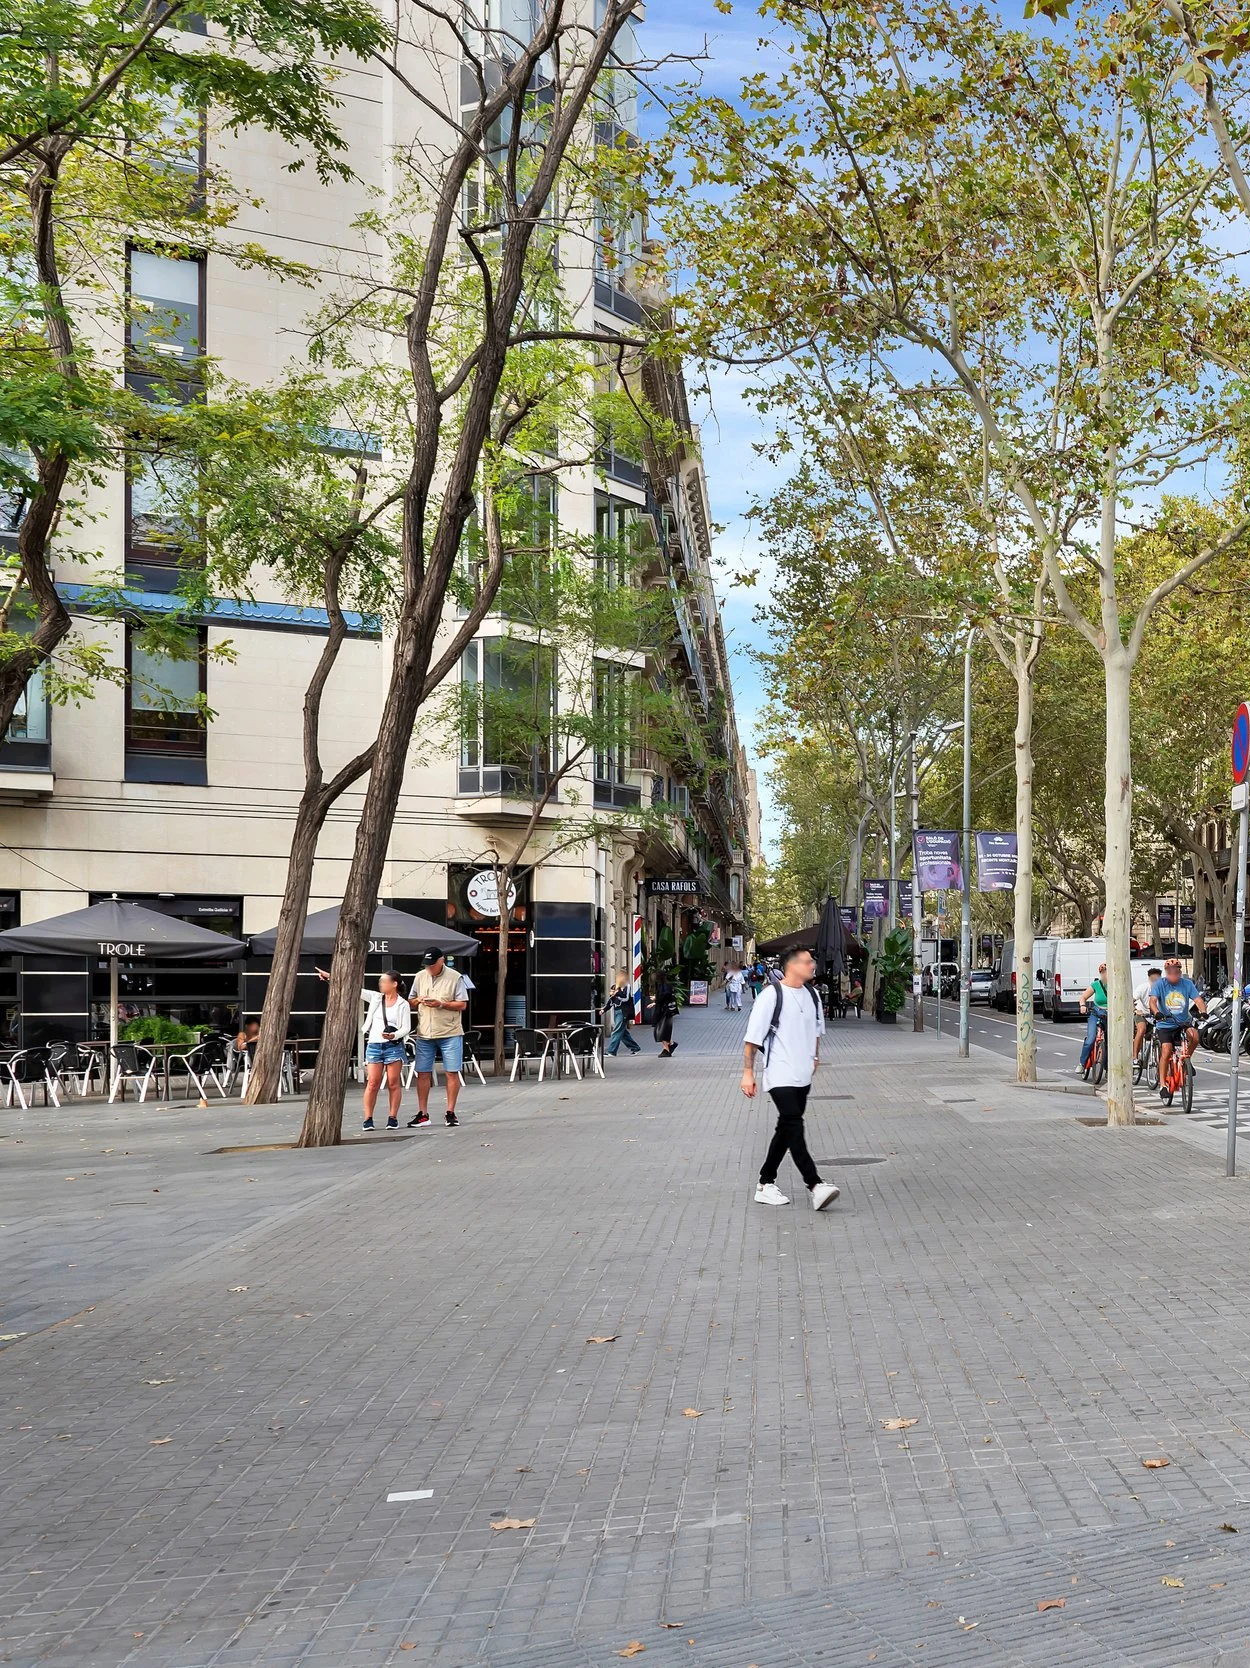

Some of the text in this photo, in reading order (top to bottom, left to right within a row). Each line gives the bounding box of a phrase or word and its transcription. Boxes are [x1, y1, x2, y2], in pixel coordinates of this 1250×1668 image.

[652, 882, 696, 891] CASA RAFOLS
[97, 942, 146, 956] TROLE
